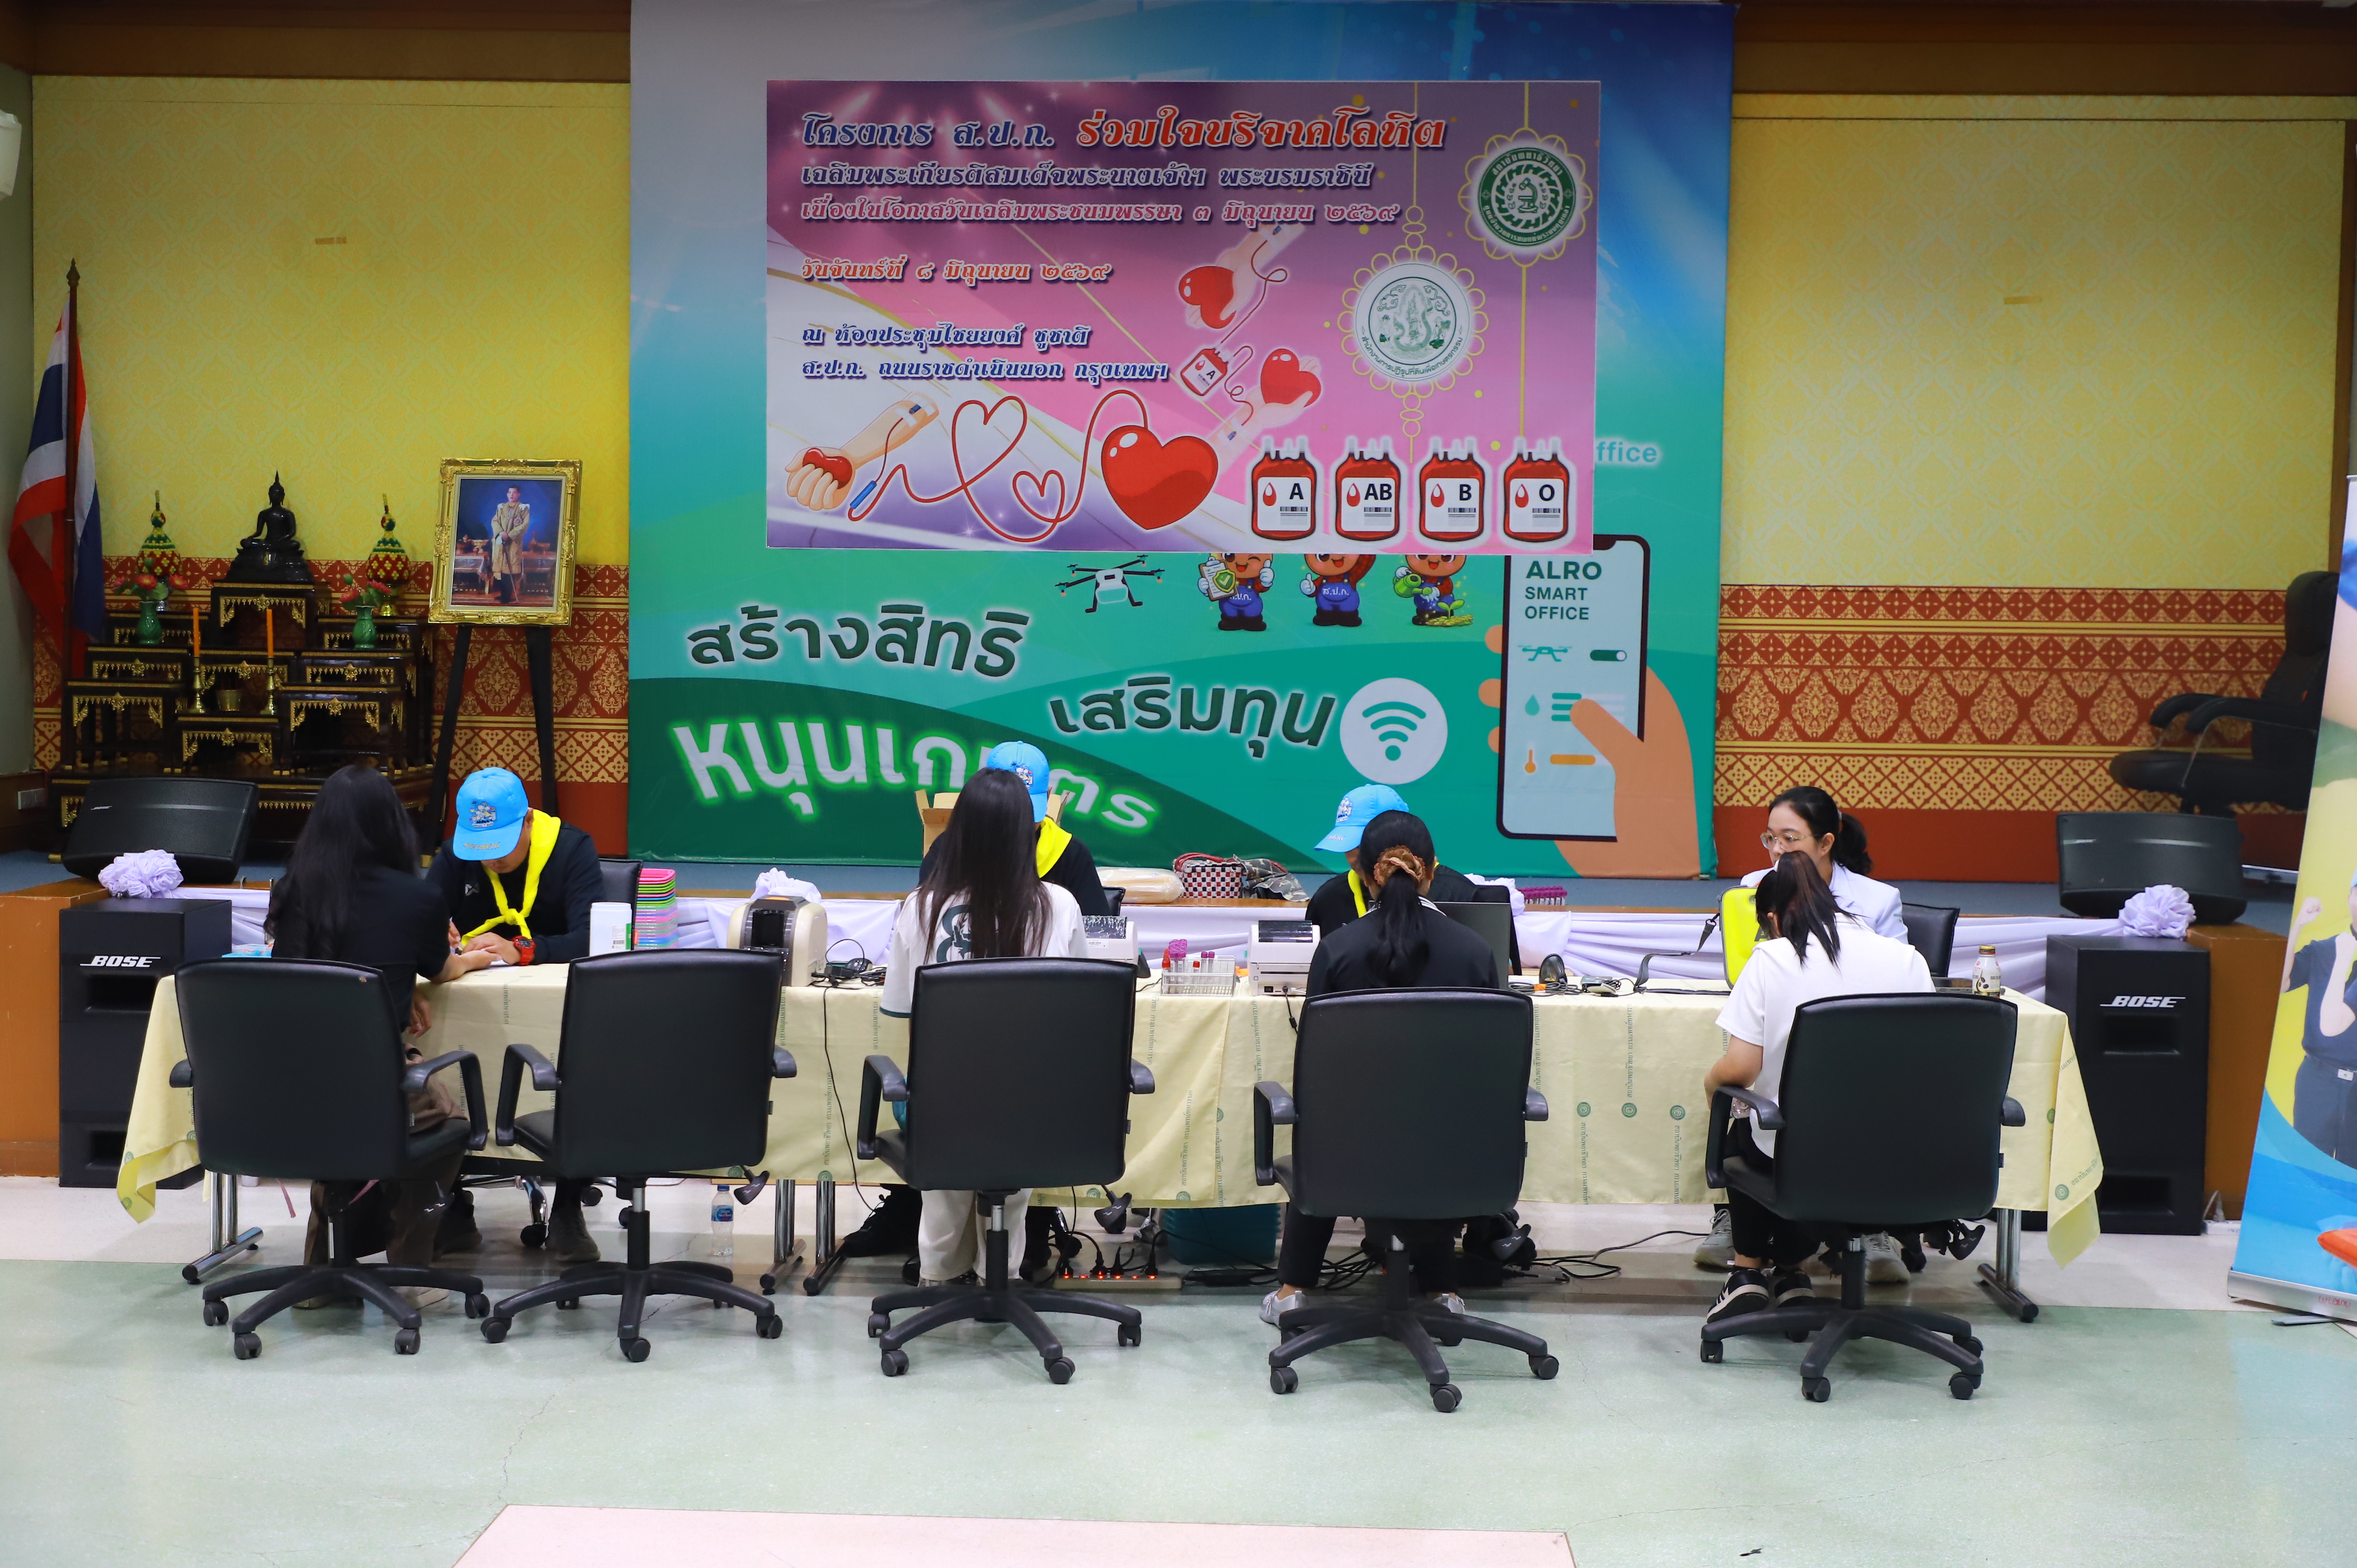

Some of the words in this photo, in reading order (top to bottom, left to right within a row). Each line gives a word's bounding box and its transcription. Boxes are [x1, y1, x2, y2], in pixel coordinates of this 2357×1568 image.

[803, 113, 932, 145] โครงการ
[954, 121, 1054, 146] ส.ป.ก.
[1078, 106, 1445, 147] ร่วมใจบริจาคโลหิต
[802, 161, 1205, 185] เฉลิมพระเกียรติสมเด็จพระนางเจ้าฯ
[1220, 164, 1373, 185] พระบรมราชินี
[802, 195, 1182, 220] เนื่องในโอกาสวันเฉลิมพระชนมพรรษา
[1194, 206, 1210, 220] ๓
[1223, 201, 1313, 227] มิถุนายน
[1326, 205, 1399, 220] ๒๕๖๙
[802, 256, 906, 278] วันจันทร์ที่
[916, 263, 934, 278] ๘
[944, 259, 1029, 284] มิถุนายน
[1041, 263, 1112, 279] ๒๕๖๙
[802, 328, 823, 342] ณ
[835, 323, 1024, 350] ห้องประชุมไชยยงค์
[1035, 326, 1090, 350] ชูชาติ
[802, 360, 863, 376] ส.ป.ก.
[879, 358, 1062, 377] ถนนราชดำเนินนอก
[1074, 363, 1168, 384] กรุงเทพฯ
[1206, 370, 1216, 380] A
[1596, 441, 1657, 463] ffice
[1289, 483, 1304, 501] A
[1364, 483, 1393, 501] AB
[1459, 484, 1472, 501] B
[1538, 484, 1555, 502] O
[1525, 560, 1602, 580] ALRO
[1230, 593, 1252, 601] .ป.ก.
[1322, 587, 1350, 596] ส.ป.ก.
[1525, 586, 1588, 601] SMART
[1525, 606, 1589, 620] OFFICE
[1049, 676, 1336, 760] เสริมทุน
[673, 722, 1156, 830] หนุนเกตร
[79, 955, 161, 968] BOSE
[2099, 995, 2186, 1008] BOSE
[1533, 1049, 1541, 1093] ถาบันพยาธิวิทยา
